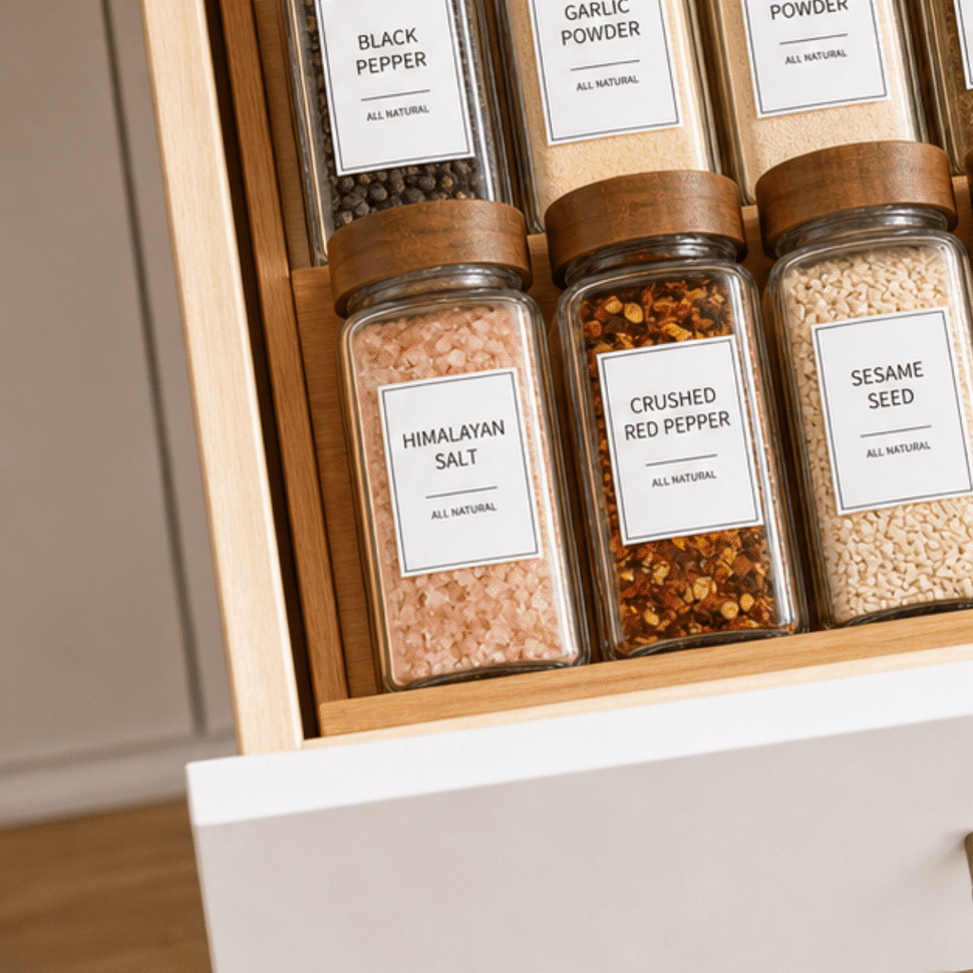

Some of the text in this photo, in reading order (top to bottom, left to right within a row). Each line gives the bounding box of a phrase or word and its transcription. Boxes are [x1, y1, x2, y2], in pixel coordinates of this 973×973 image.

[357, 27, 418, 51] BLACK
[560, 20, 641, 46] POWDER
[355, 51, 427, 76] PEPPER
[785, 49, 847, 65] ALL NATURAL
[576, 75, 639, 91] ALL NATURAL
[366, 105, 429, 122] ALL NATURAL
[850, 360, 924, 387] SESAME
[630, 386, 717, 414] CRUSHED
[867, 387, 915, 410] SEED
[402, 419, 505, 449] HIMALAYAN
[624, 410, 731, 441] RED PEPPER
[434, 448, 477, 471] SALT
[866, 441, 931, 458] ALL NATURAL
[652, 471, 717, 488] ALL NATURAL
[431, 503, 496, 520] ALL NATURAL
